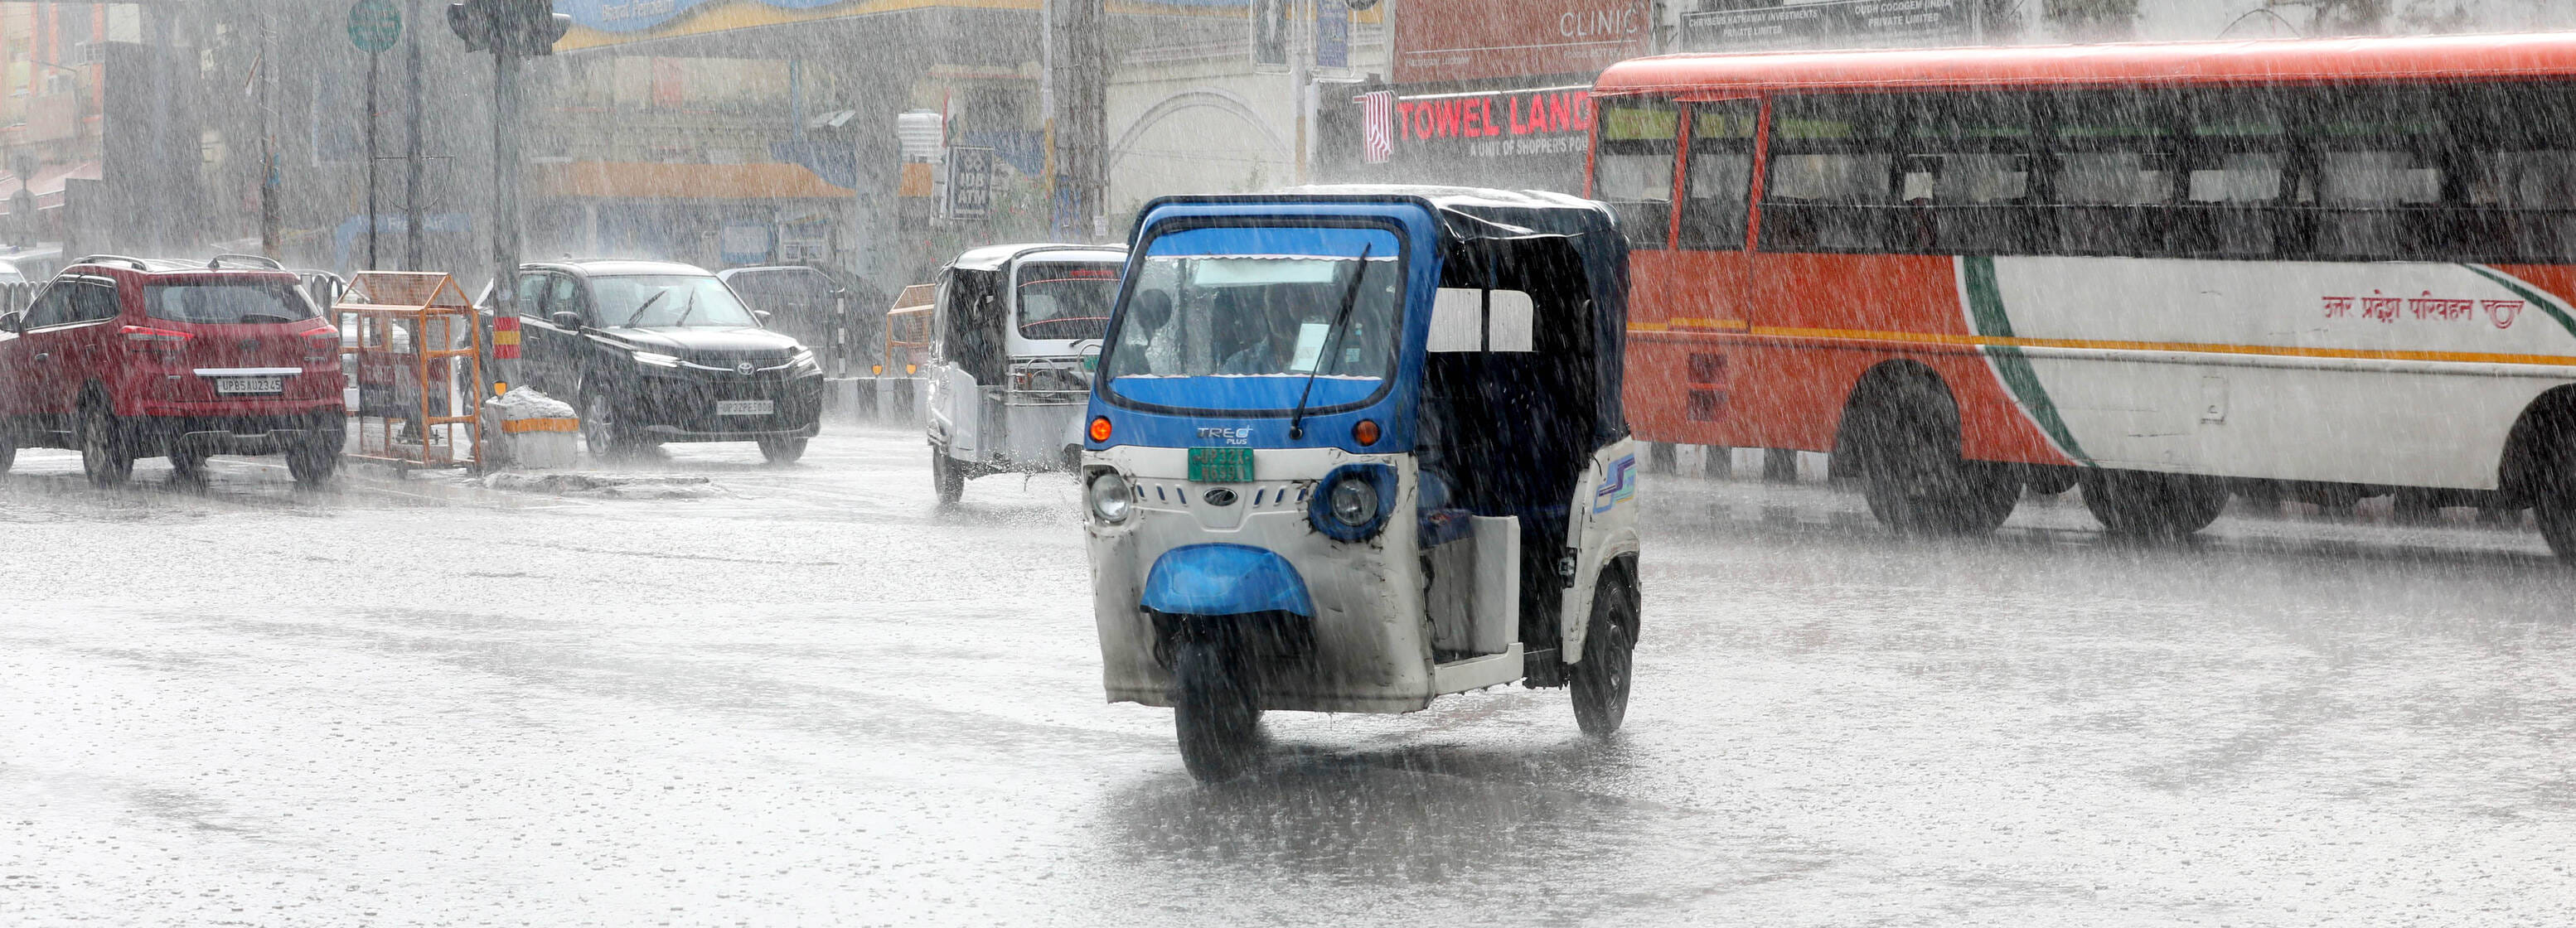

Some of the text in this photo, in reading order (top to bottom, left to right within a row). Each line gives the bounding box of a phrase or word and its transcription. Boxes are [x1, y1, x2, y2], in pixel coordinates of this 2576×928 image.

[1560, 8, 1638, 36] CLINIC
[1728, 13, 1765, 25] HATHAWAY
[1768, 9, 1818, 22] INVESTMENTS
[1868, 13, 1939, 27] PRIVATE LIMITED
[1723, 26, 1782, 36] PRIVATE LIMITED
[1396, 90, 1592, 140] TOWEL LAND
[1470, 142, 1477, 157] A
[1479, 141, 1501, 157] UNIT
[1503, 140, 1514, 155] OF
[1517, 137, 1566, 155] SHOPPER'S
[958, 190, 986, 205] ATM
[2322, 289, 2473, 323] उत्तर प्रदेश परिवहन
[222, 380, 281, 391] UP85AU2345
